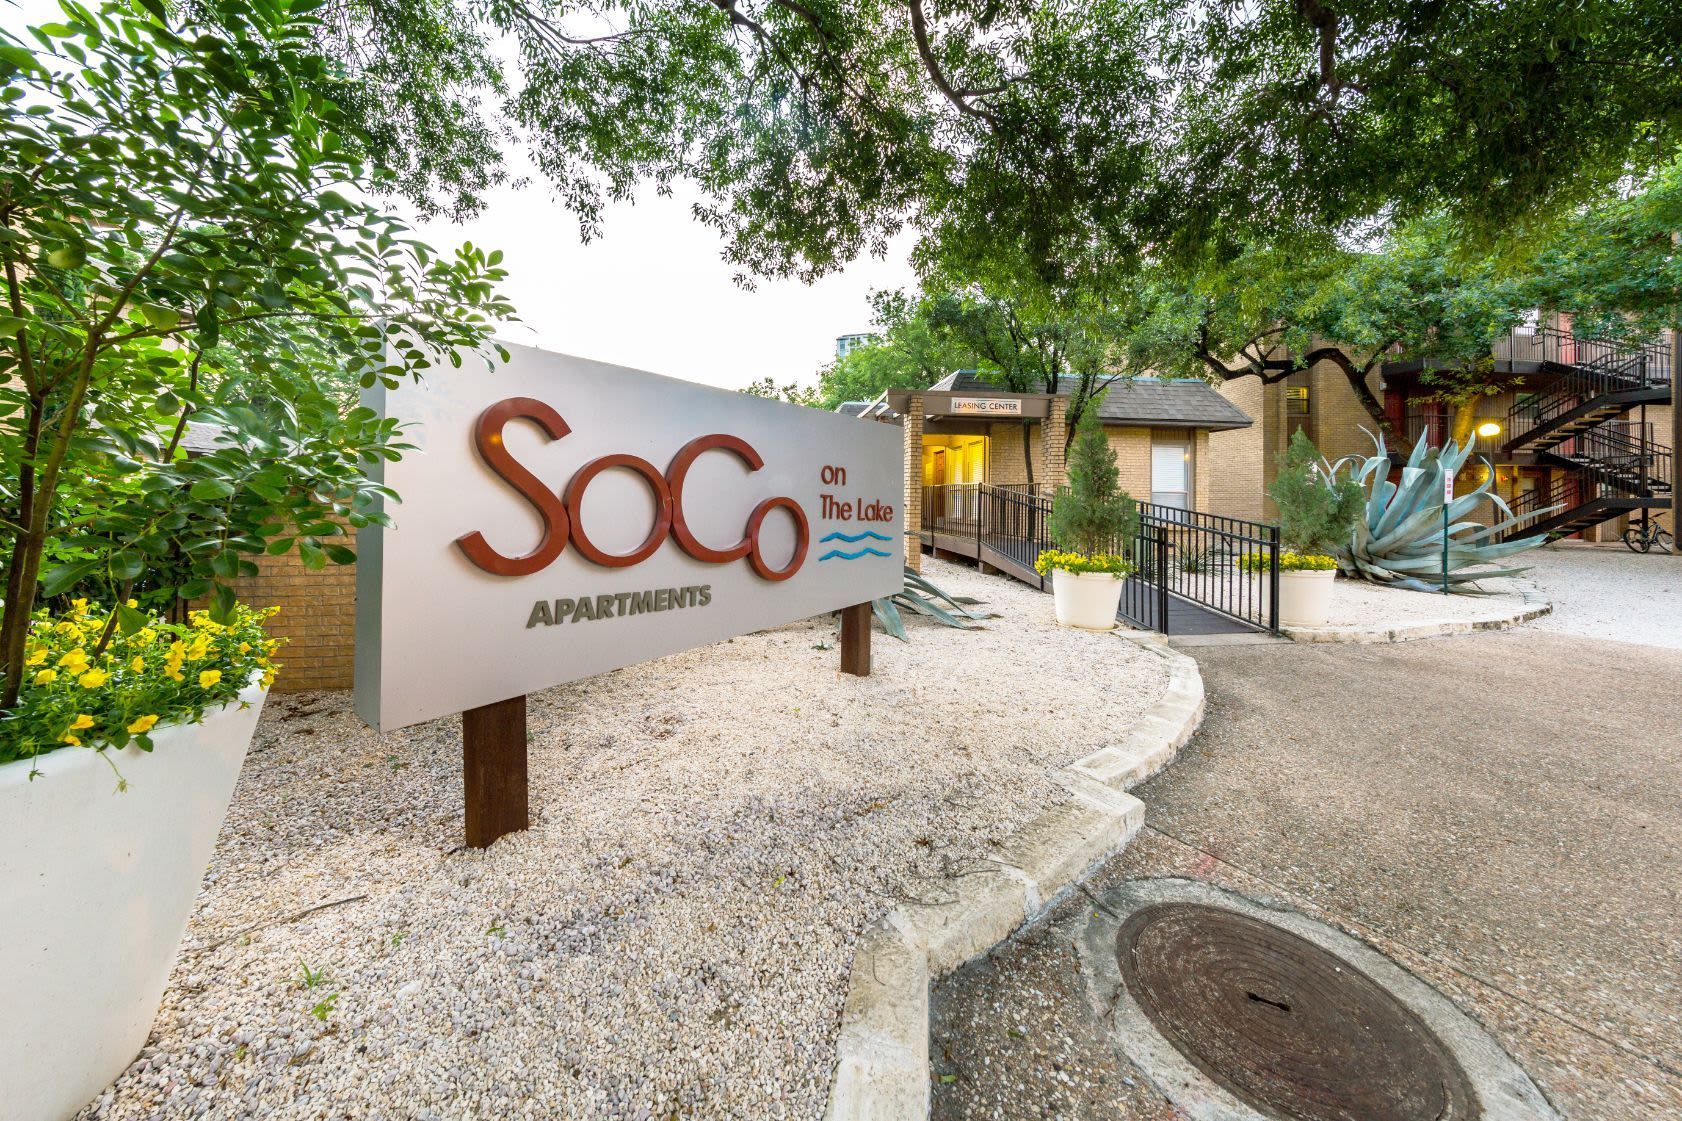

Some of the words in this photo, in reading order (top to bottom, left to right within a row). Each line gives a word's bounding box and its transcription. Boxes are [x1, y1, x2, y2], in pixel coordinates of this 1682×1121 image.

[954, 401, 986, 410] LEASING
[989, 402, 1018, 411] CENTER
[456, 397, 810, 582] SoCo
[821, 465, 847, 486] on
[820, 494, 853, 521] The
[857, 497, 894, 522] Lake
[526, 584, 712, 629] APARTMENTS
